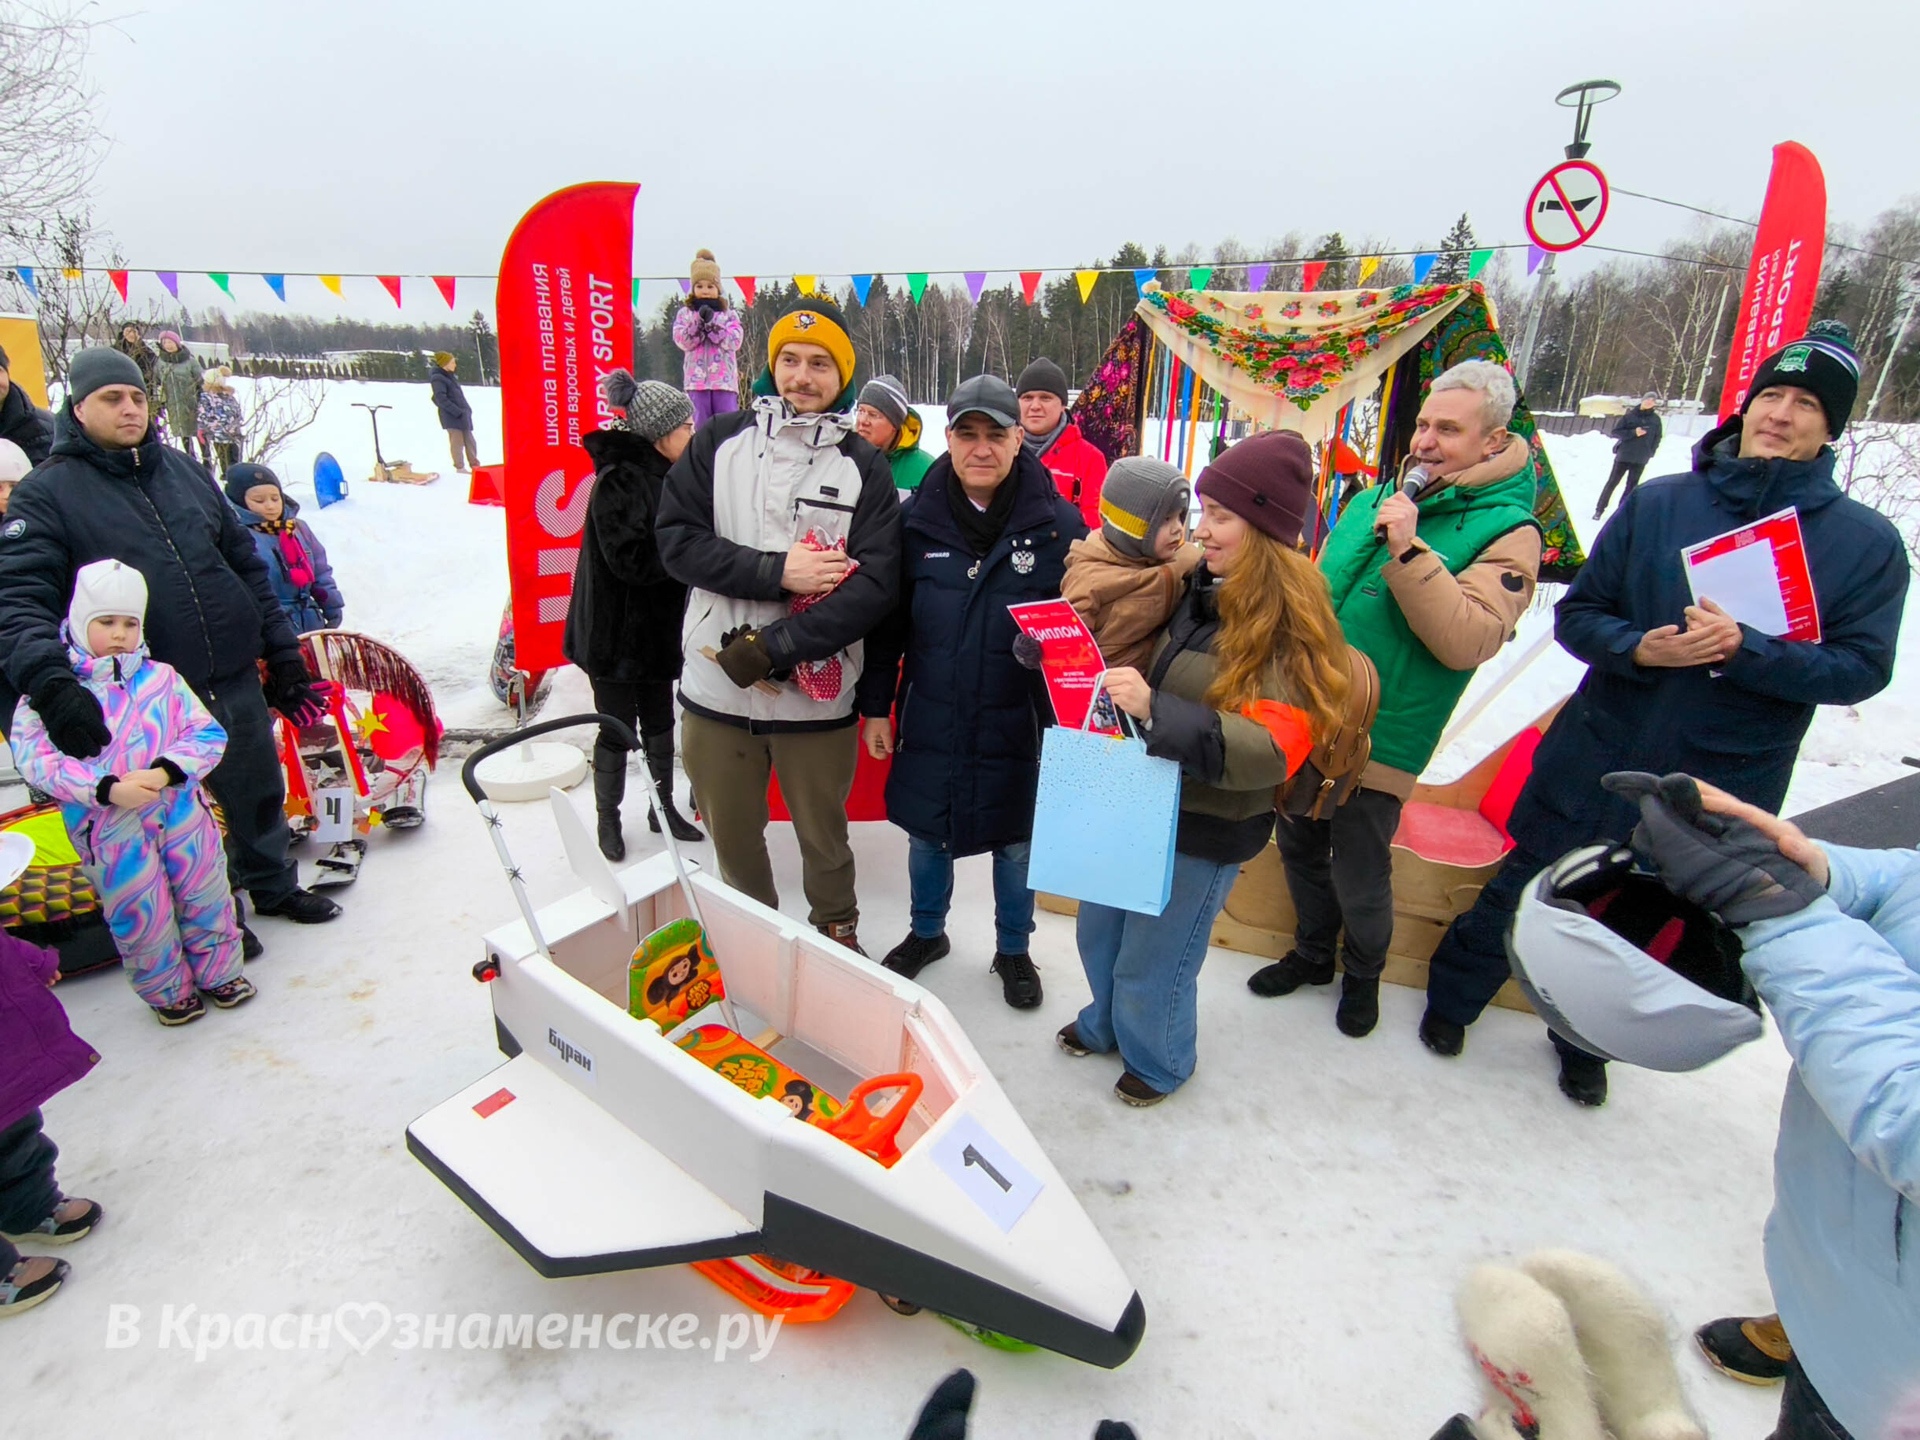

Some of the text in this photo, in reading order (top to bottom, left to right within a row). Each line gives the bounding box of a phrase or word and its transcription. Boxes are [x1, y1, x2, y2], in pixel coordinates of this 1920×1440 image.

[588, 273, 615, 431] ARDY SPORT
[1739, 254, 1769, 380] плавания
[1767, 239, 1802, 348] SPORT
[533, 263, 559, 446] школа плавания
[556, 267, 583, 447] для взрослых и детей
[325, 797, 342, 825] 4
[548, 1027, 592, 1072] Буран
[962, 1143, 1013, 1193] 1
